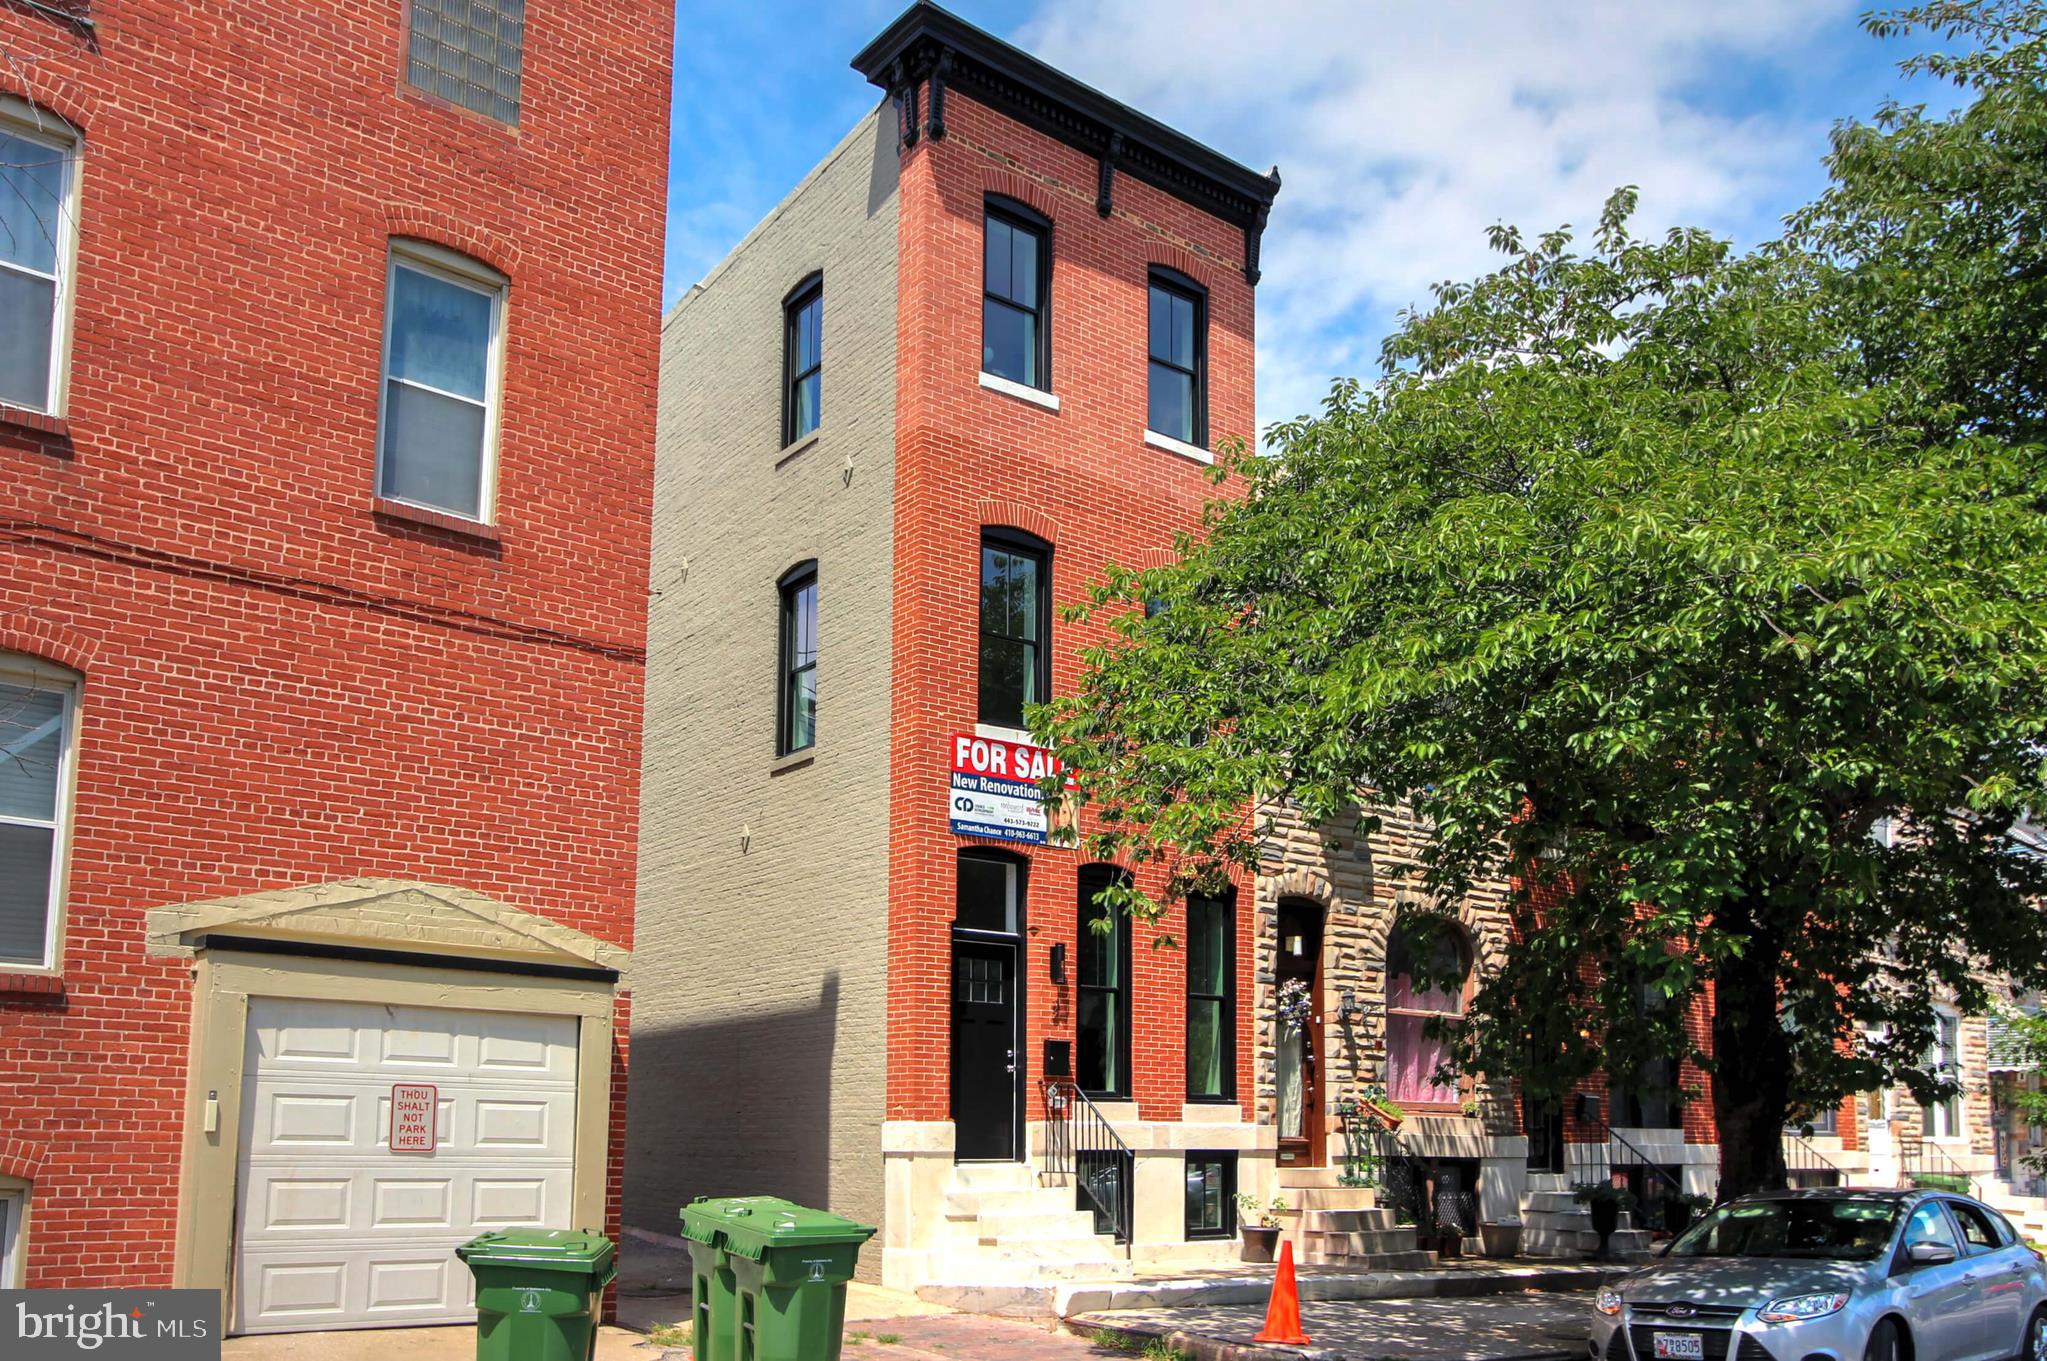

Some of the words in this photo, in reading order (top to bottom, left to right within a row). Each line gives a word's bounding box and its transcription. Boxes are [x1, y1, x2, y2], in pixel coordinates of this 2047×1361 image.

[956, 737, 1007, 775] FOR
[953, 773, 978, 789] New
[980, 777, 1045, 800] Renovation.
[956, 822, 984, 833] Samantha
[401, 1090, 428, 1099] THOU
[398, 1102, 430, 1111] SHALT
[403, 1113, 423, 1122] NOT
[399, 1125, 426, 1134] PARK
[399, 1136, 426, 1145] HERE
